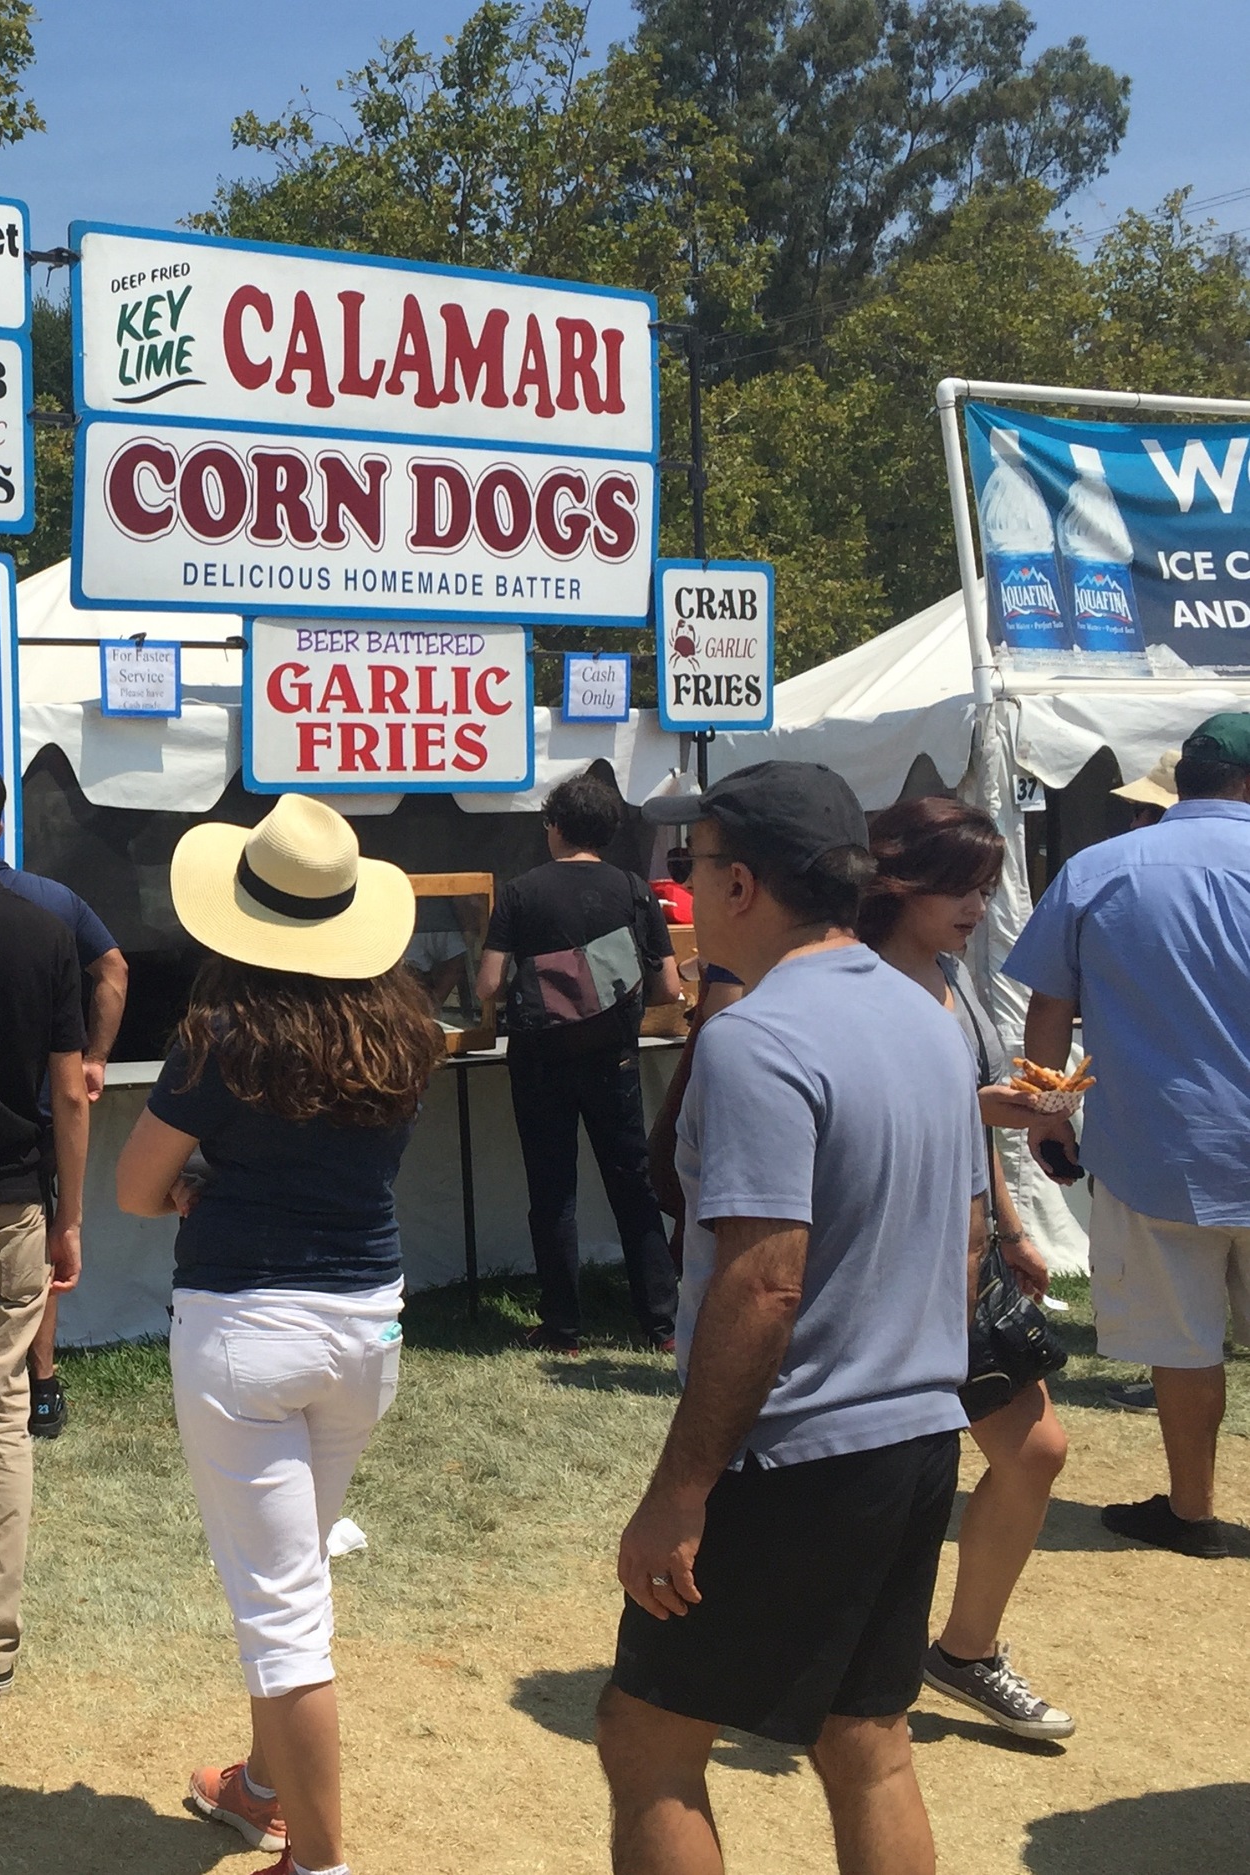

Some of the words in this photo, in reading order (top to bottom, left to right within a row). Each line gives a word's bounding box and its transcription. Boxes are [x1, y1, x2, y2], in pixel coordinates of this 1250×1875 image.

[111, 272, 146, 293] DEEP
[151, 262, 191, 283] FRIED
[116, 284, 193, 348] KEY
[118, 335, 196, 387] LIME
[222, 284, 626, 419] CALAMARI
[103, 435, 392, 552] CORN
[405, 456, 640, 565] DOGS
[182, 562, 332, 591] DELICIOUS
[344, 568, 484, 597] HOMEMADE
[495, 575, 582, 601] BATTER
[1157, 550, 1217, 581] ICE
[674, 587, 758, 620] CRAB
[1000, 580, 1061, 617] AQUAFINA
[1074, 583, 1133, 622] AQUAFINA
[1174, 600, 1250, 629] AND
[112, 649, 132, 662] For
[135, 649, 170, 662] Faster
[296, 628, 360, 653] BEER
[366, 629, 485, 656] BATTERED
[705, 637, 758, 659] GARLIC
[119, 668, 165, 683] Service
[266, 662, 513, 716] GARLIC
[582, 665, 615, 682] Cash
[672, 673, 762, 707] FRIES
[581, 688, 615, 709] Only
[296, 722, 488, 772] FRIES
[1017, 776, 1038, 801] 37
